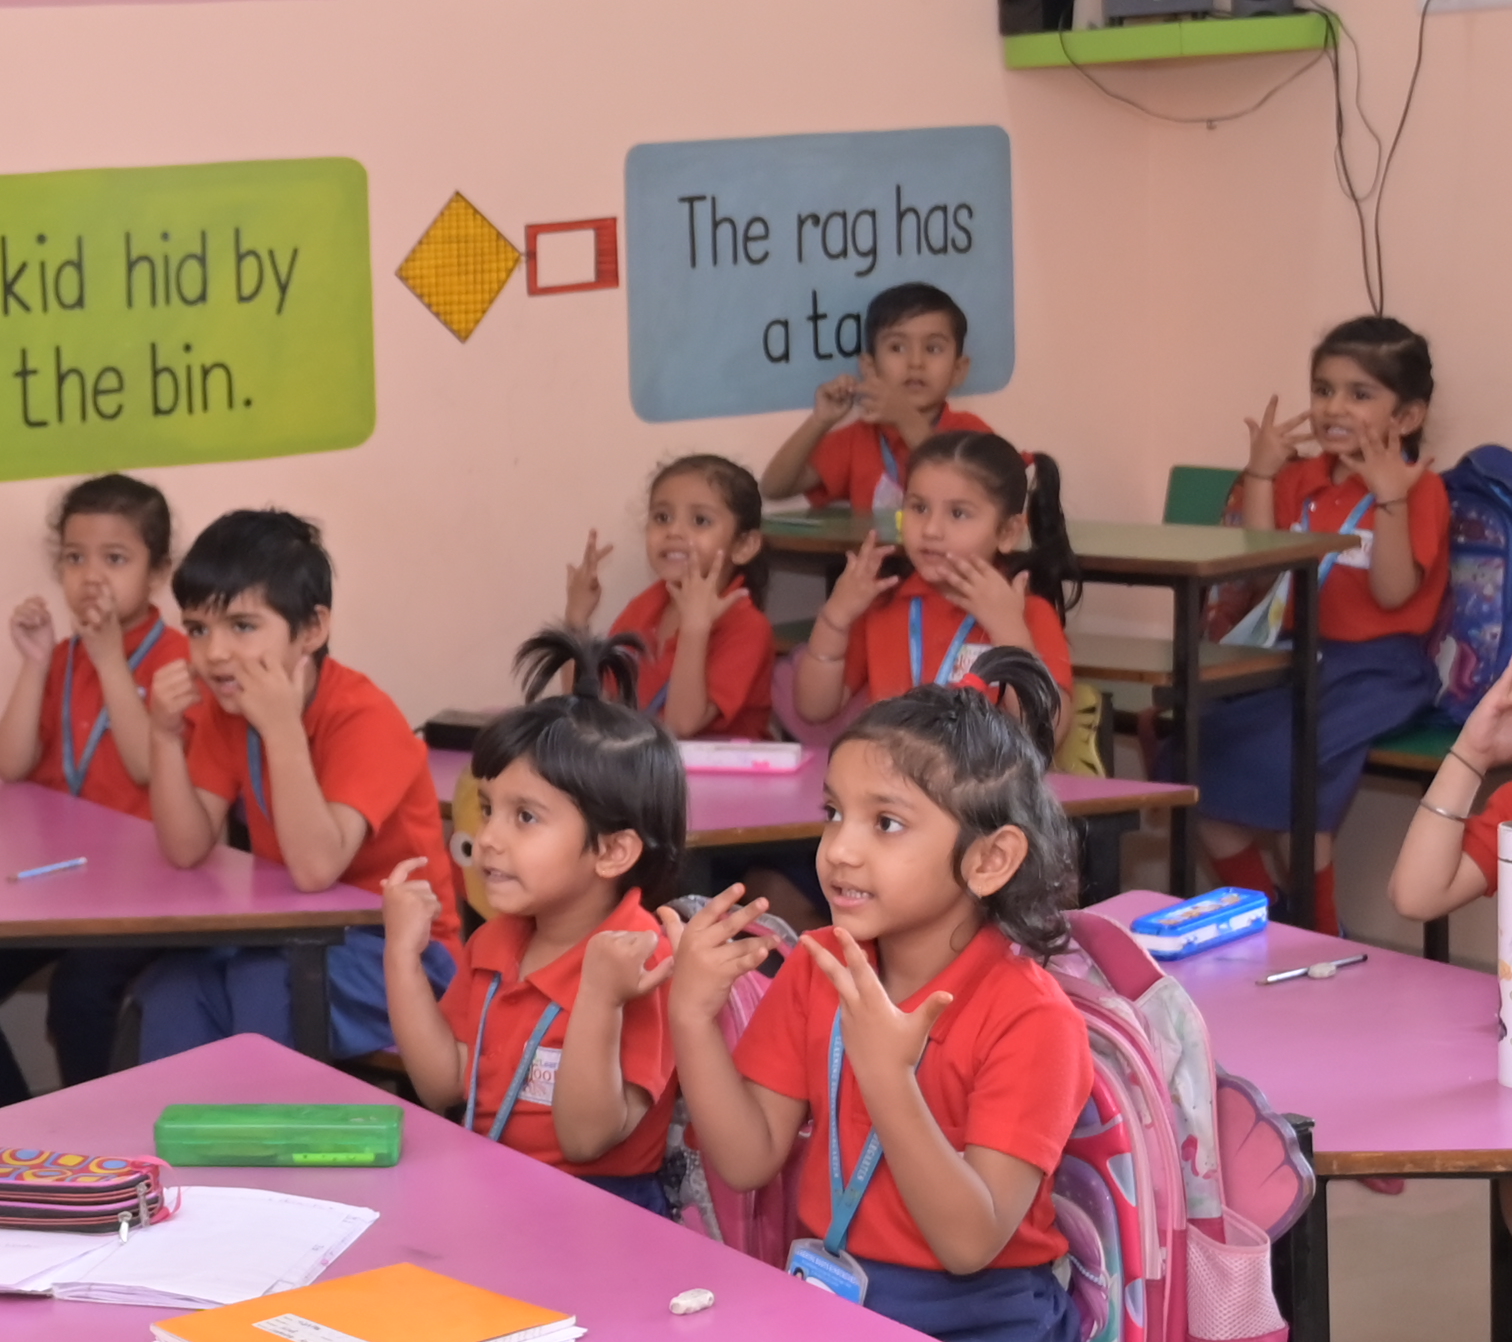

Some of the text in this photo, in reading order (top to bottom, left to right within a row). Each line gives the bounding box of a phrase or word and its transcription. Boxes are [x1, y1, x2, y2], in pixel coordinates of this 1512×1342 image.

[1, 234, 85, 316] kid
[126, 231, 208, 308] hid
[234, 228, 298, 314] by
[679, 185, 973, 277] The rag has
[763, 291, 861, 363] a ta
[14, 343, 252, 428] the bin.
